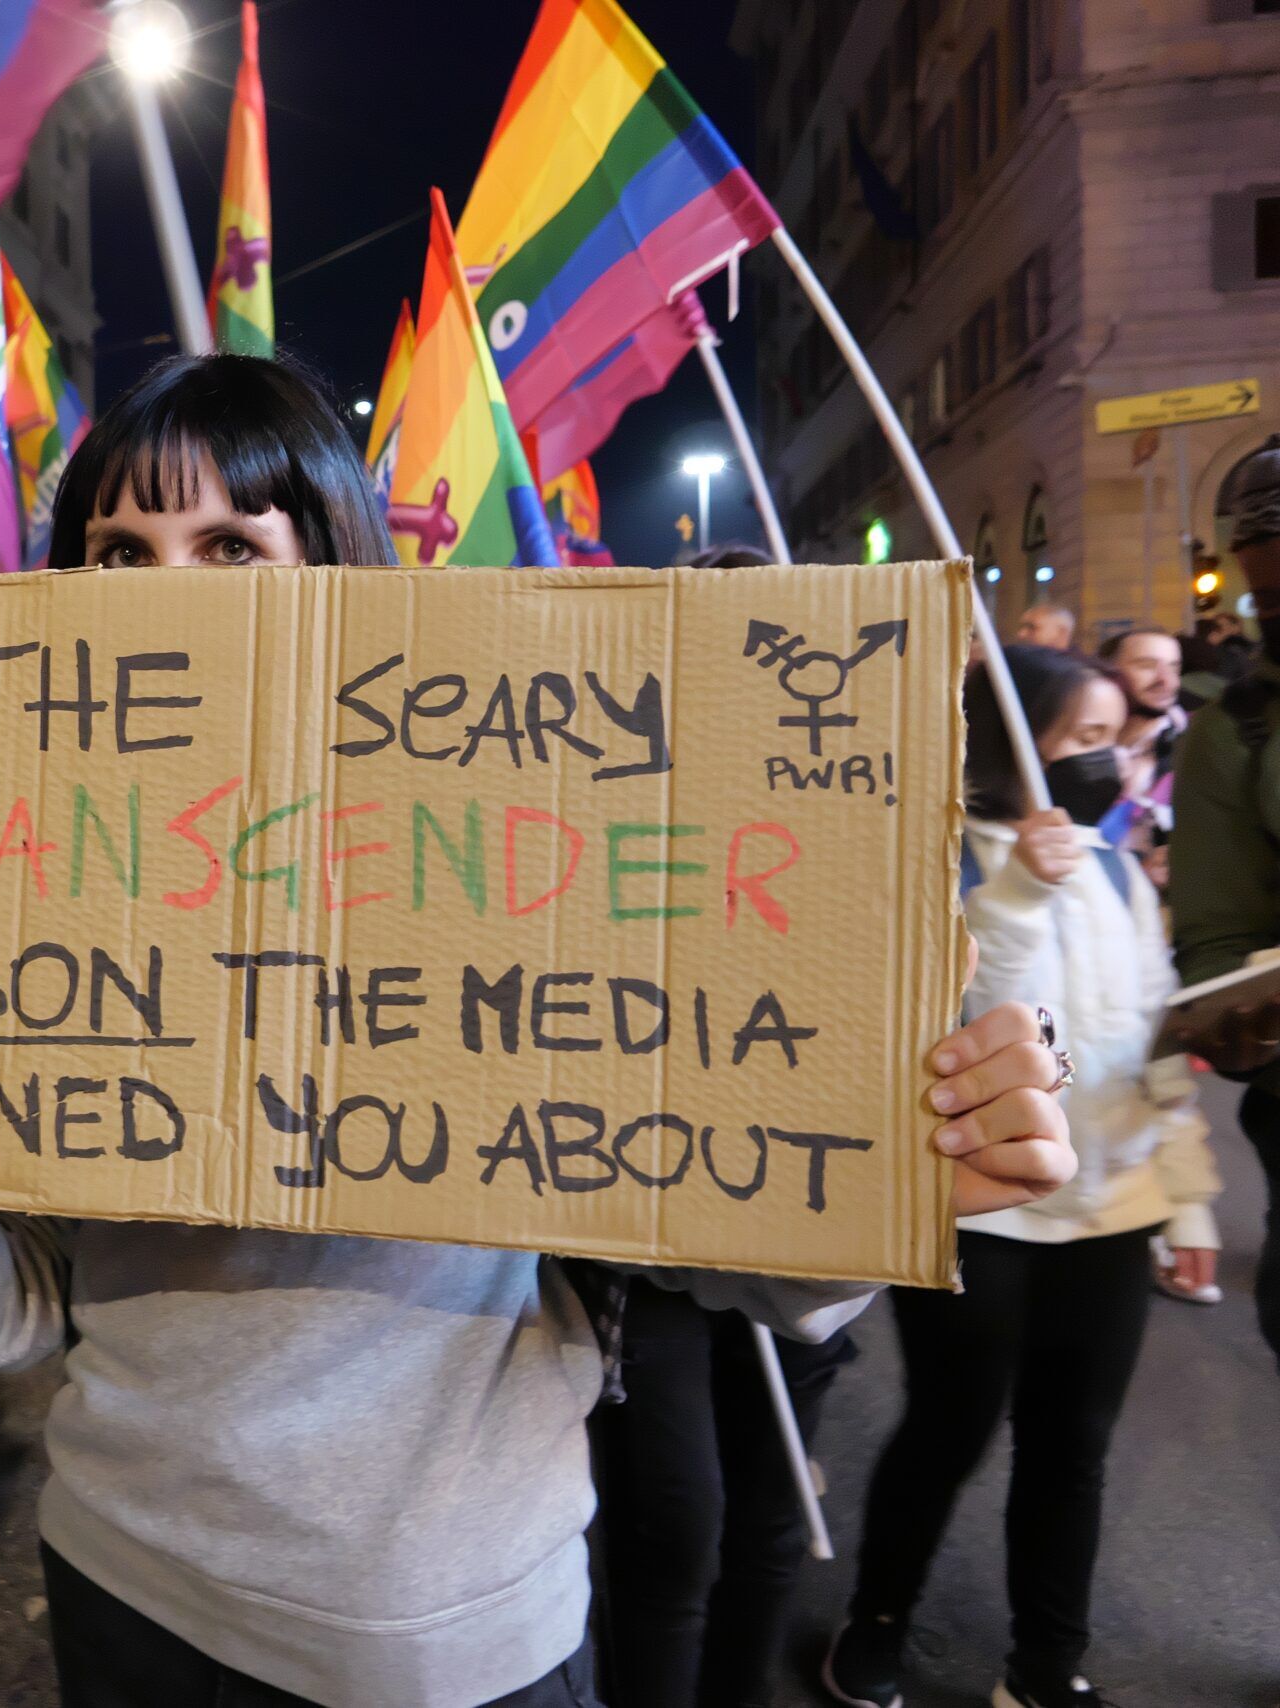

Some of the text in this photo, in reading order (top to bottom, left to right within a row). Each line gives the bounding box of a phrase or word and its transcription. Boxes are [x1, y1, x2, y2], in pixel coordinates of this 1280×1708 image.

[763, 752, 896, 807] PWR!
[212, 951, 427, 1048] THE
[460, 963, 818, 1070] MEDIA
[256, 1072, 449, 1189] YOU
[477, 1099, 874, 1213] ABOUT
